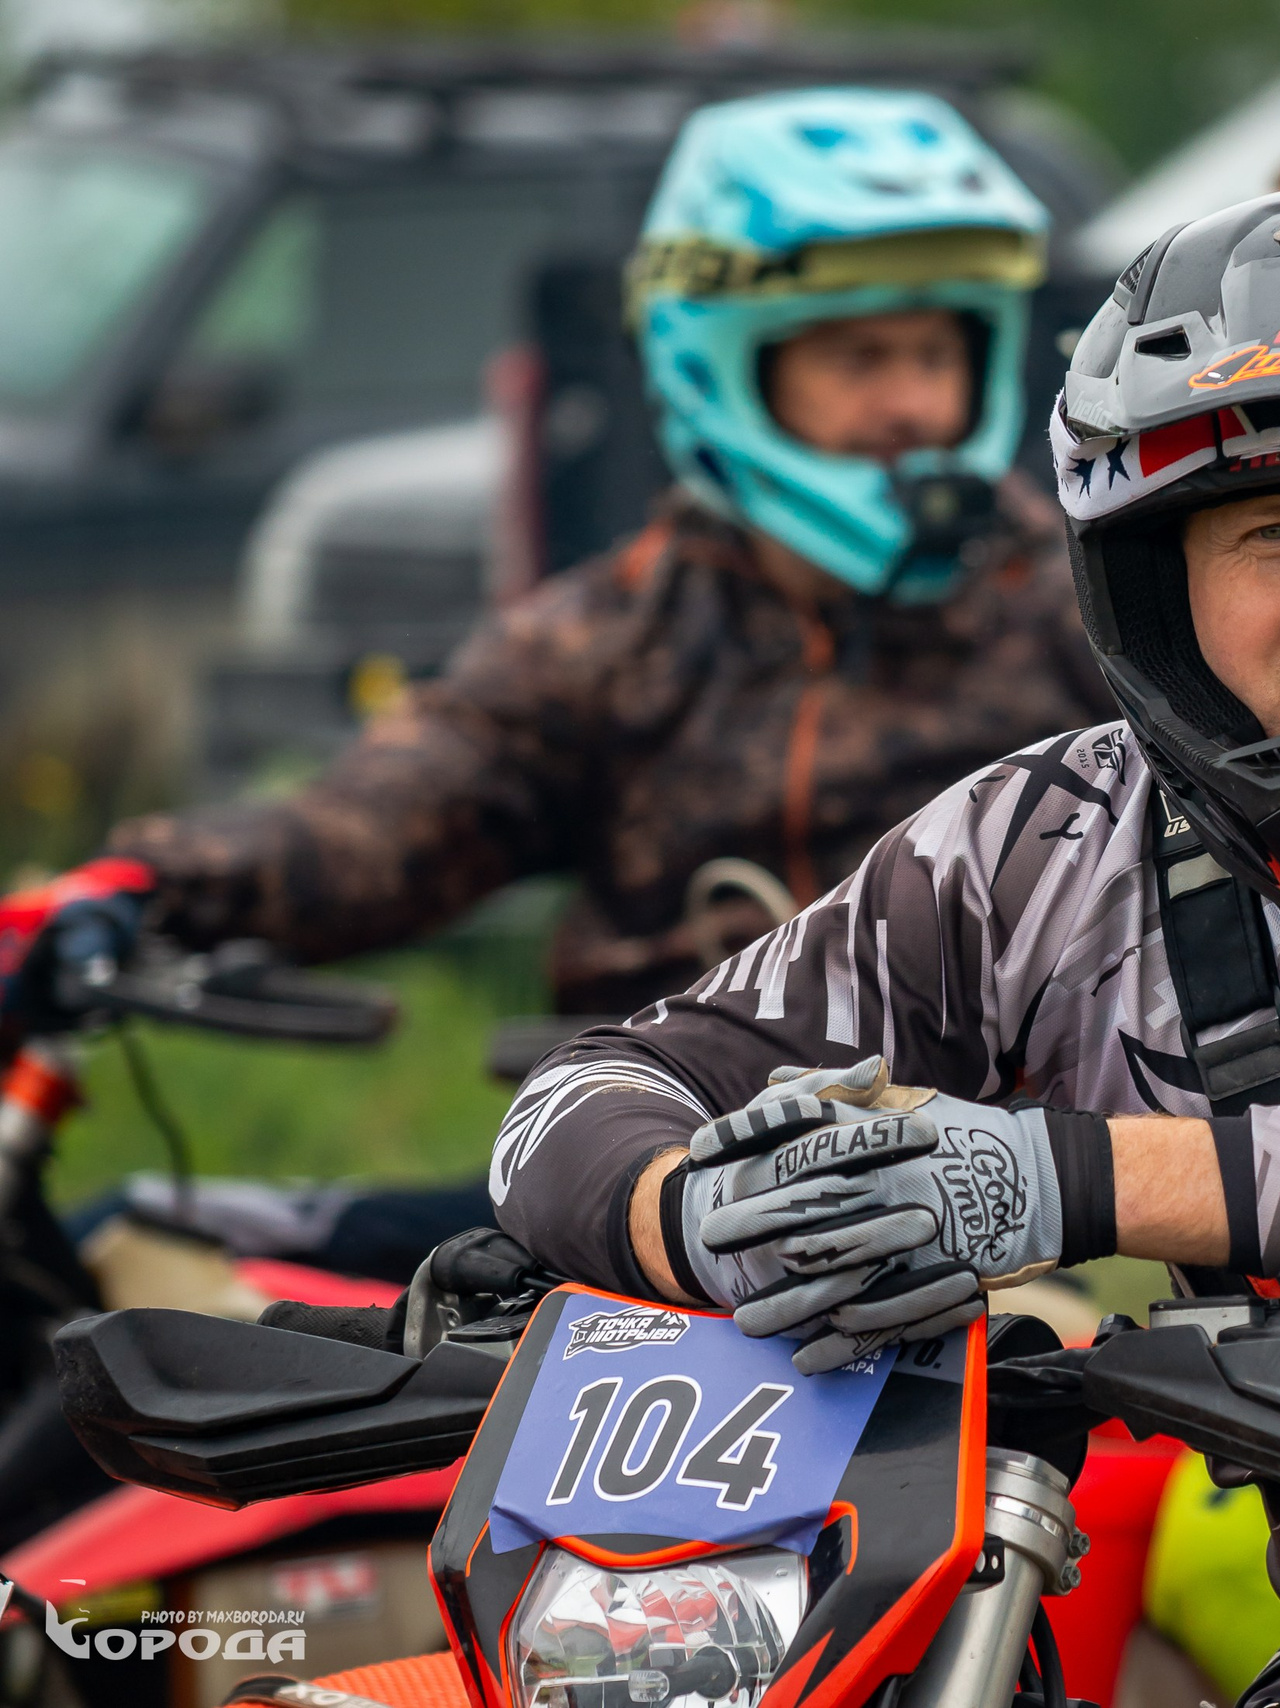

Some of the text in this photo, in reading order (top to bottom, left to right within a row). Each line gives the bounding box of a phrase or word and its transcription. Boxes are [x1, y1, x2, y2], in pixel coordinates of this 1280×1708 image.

[1076, 748, 1090, 769] 2015
[1163, 819, 1191, 838] US
[774, 1116, 911, 1186] FOXPLAST
[969, 1129, 1028, 1246] Good
[596, 1317, 655, 1331] ТОЧКА
[546, 1374, 794, 1512] 104
